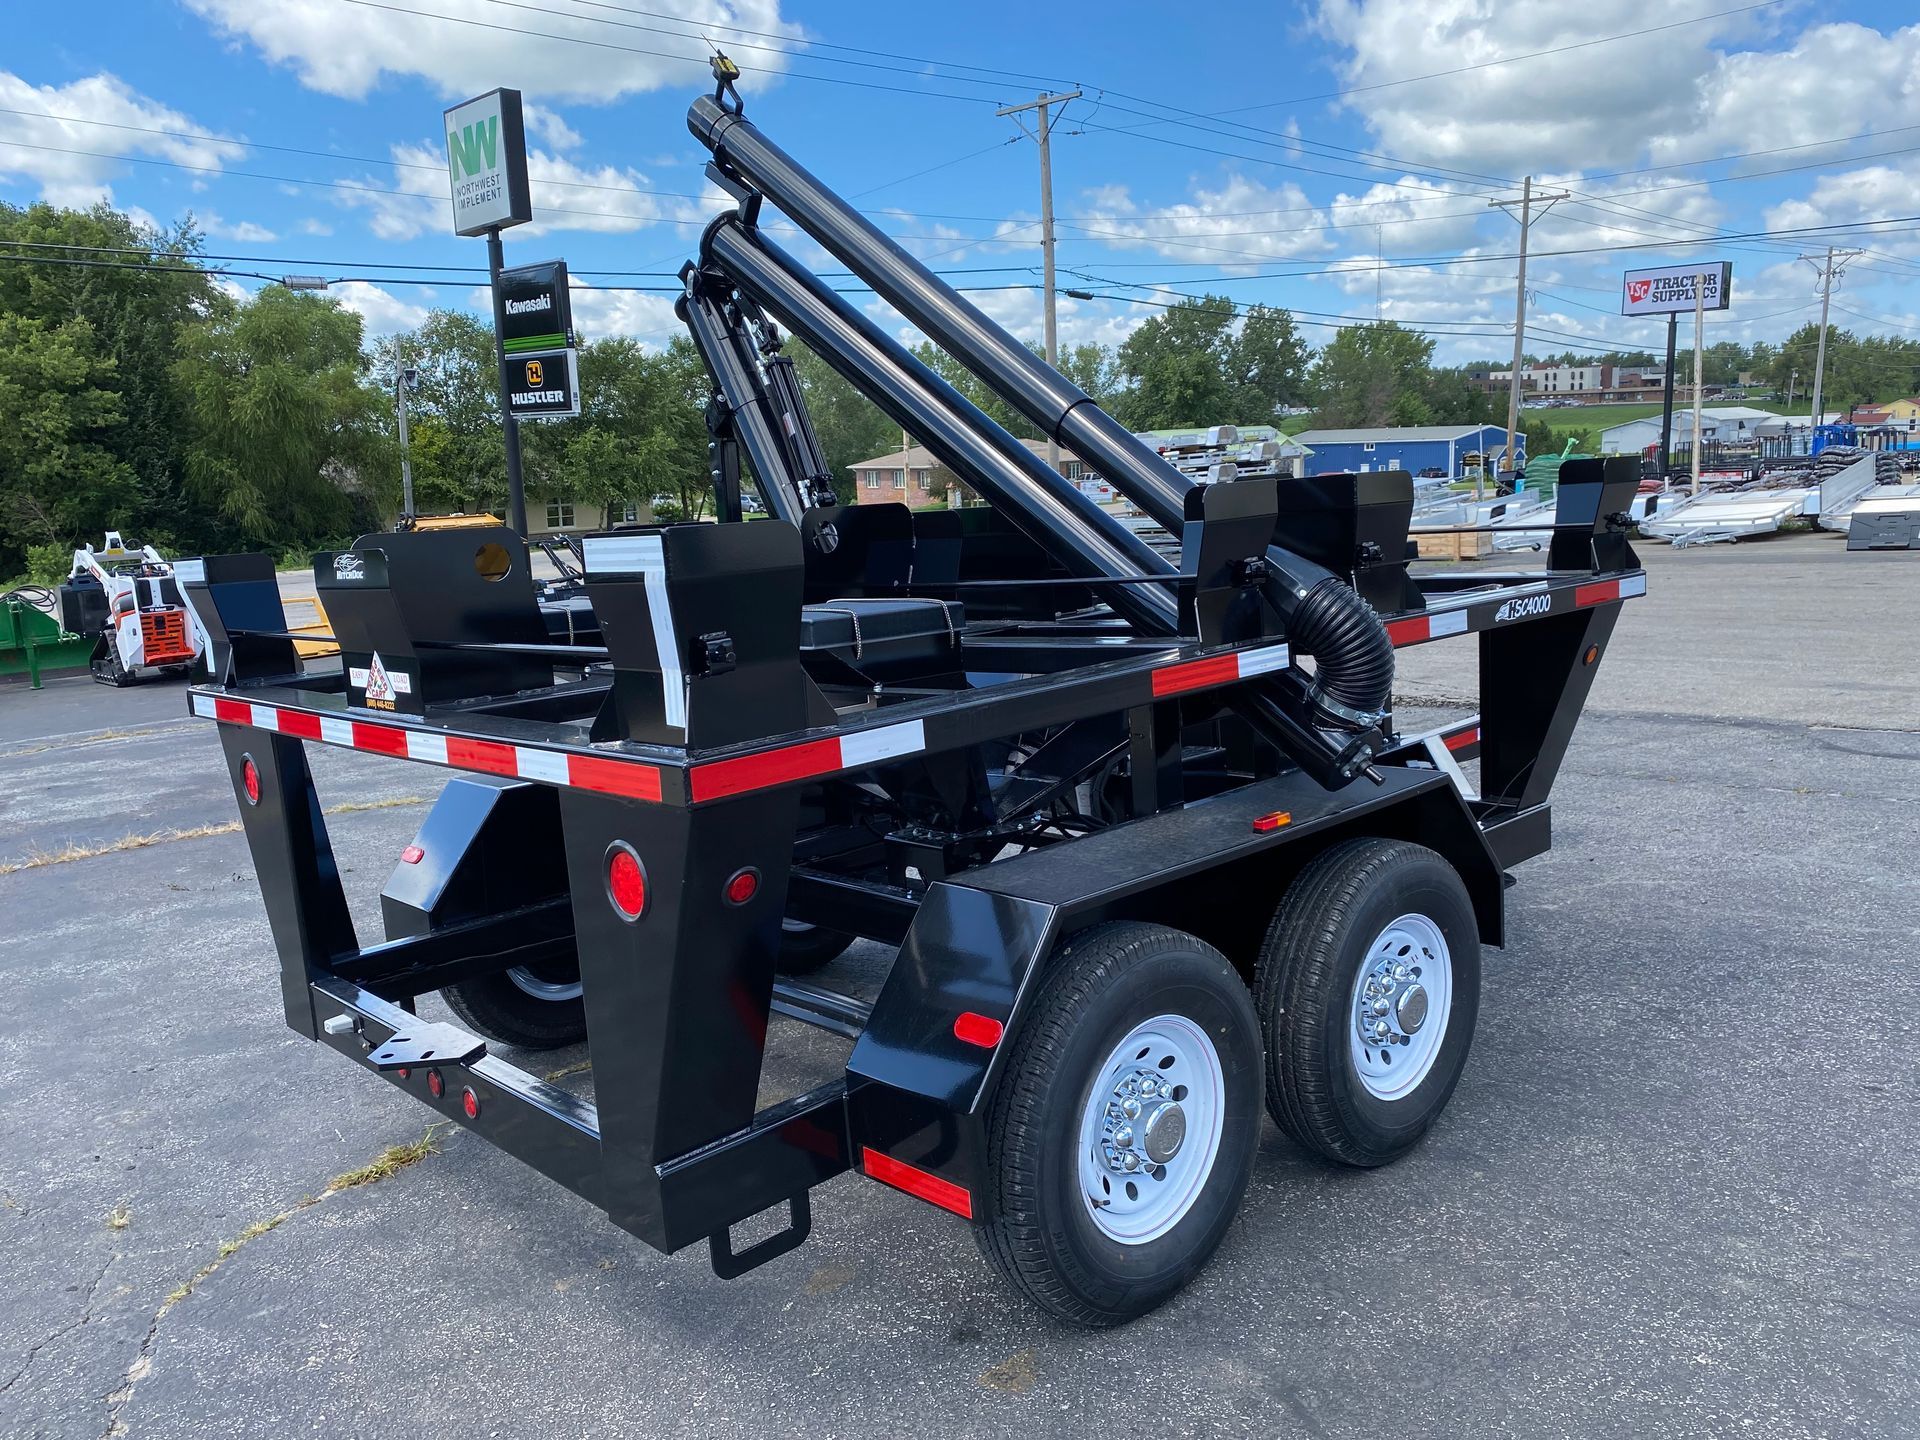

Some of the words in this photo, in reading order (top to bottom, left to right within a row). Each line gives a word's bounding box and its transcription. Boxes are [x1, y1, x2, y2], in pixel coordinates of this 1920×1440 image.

[449, 115, 497, 181] NW
[457, 174, 501, 198] NORTHWEST
[458, 187, 502, 210] IMPLEMENT
[1628, 282, 1648, 299] TSC
[505, 293, 552, 315] Kawasaki
[511, 390, 565, 405] HUSTLER
[371, 689, 386, 699] CART
